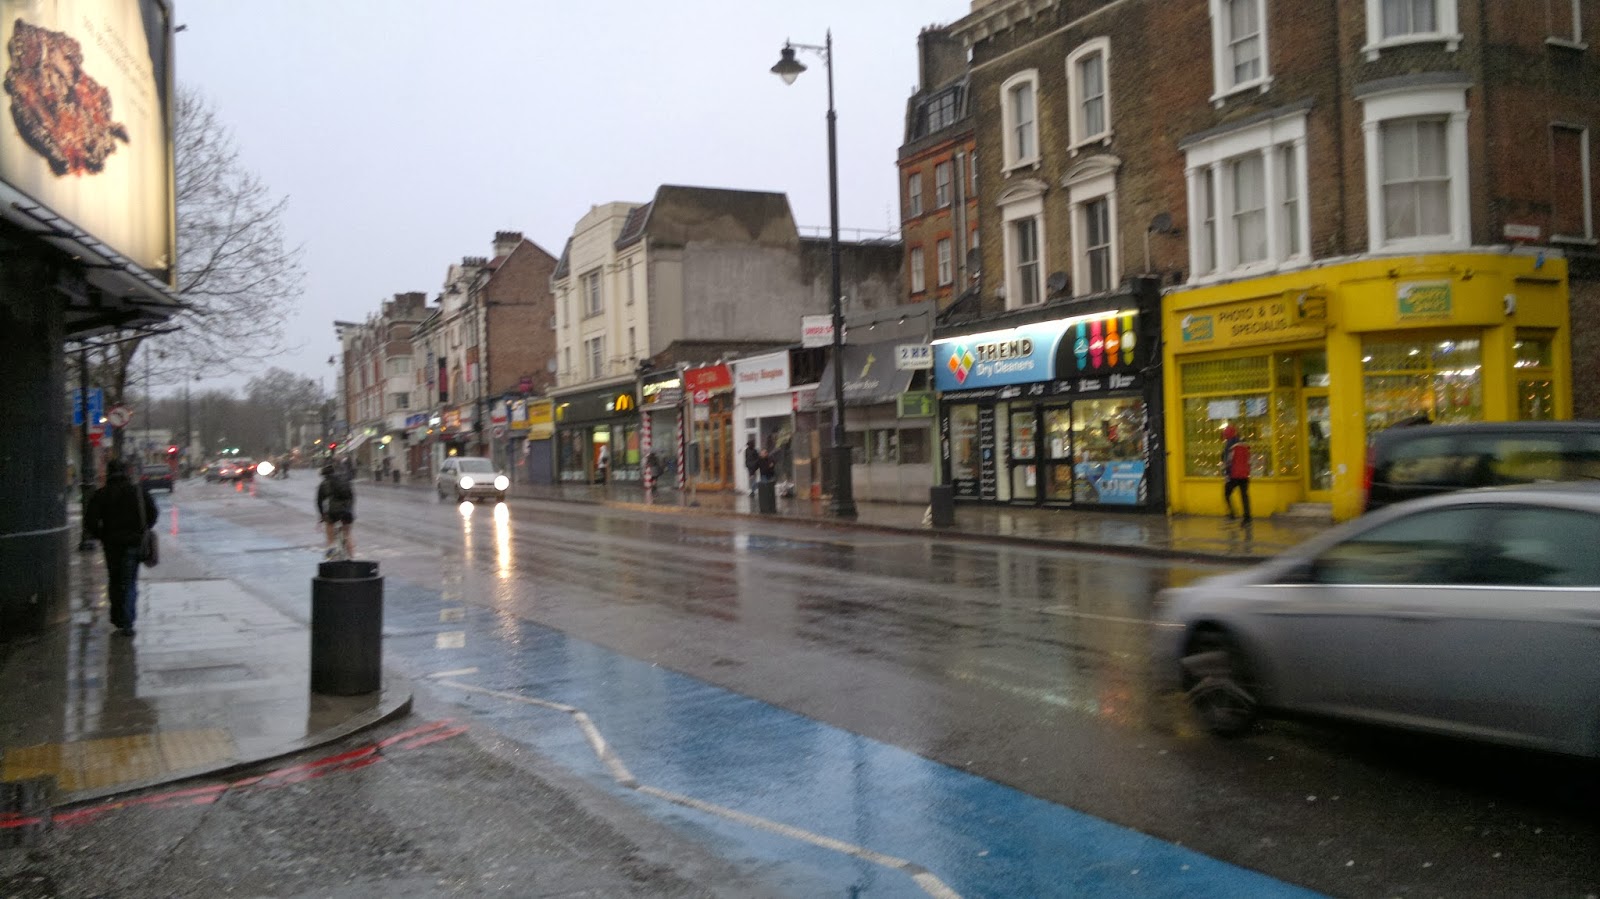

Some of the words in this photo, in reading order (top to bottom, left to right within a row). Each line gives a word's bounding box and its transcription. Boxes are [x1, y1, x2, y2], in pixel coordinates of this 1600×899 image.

[1218, 307, 1254, 322] PHOTO
[975, 338, 1034, 363] TREND
[976, 363, 993, 378] Dry
[994, 360, 1034, 374] Cleaners
